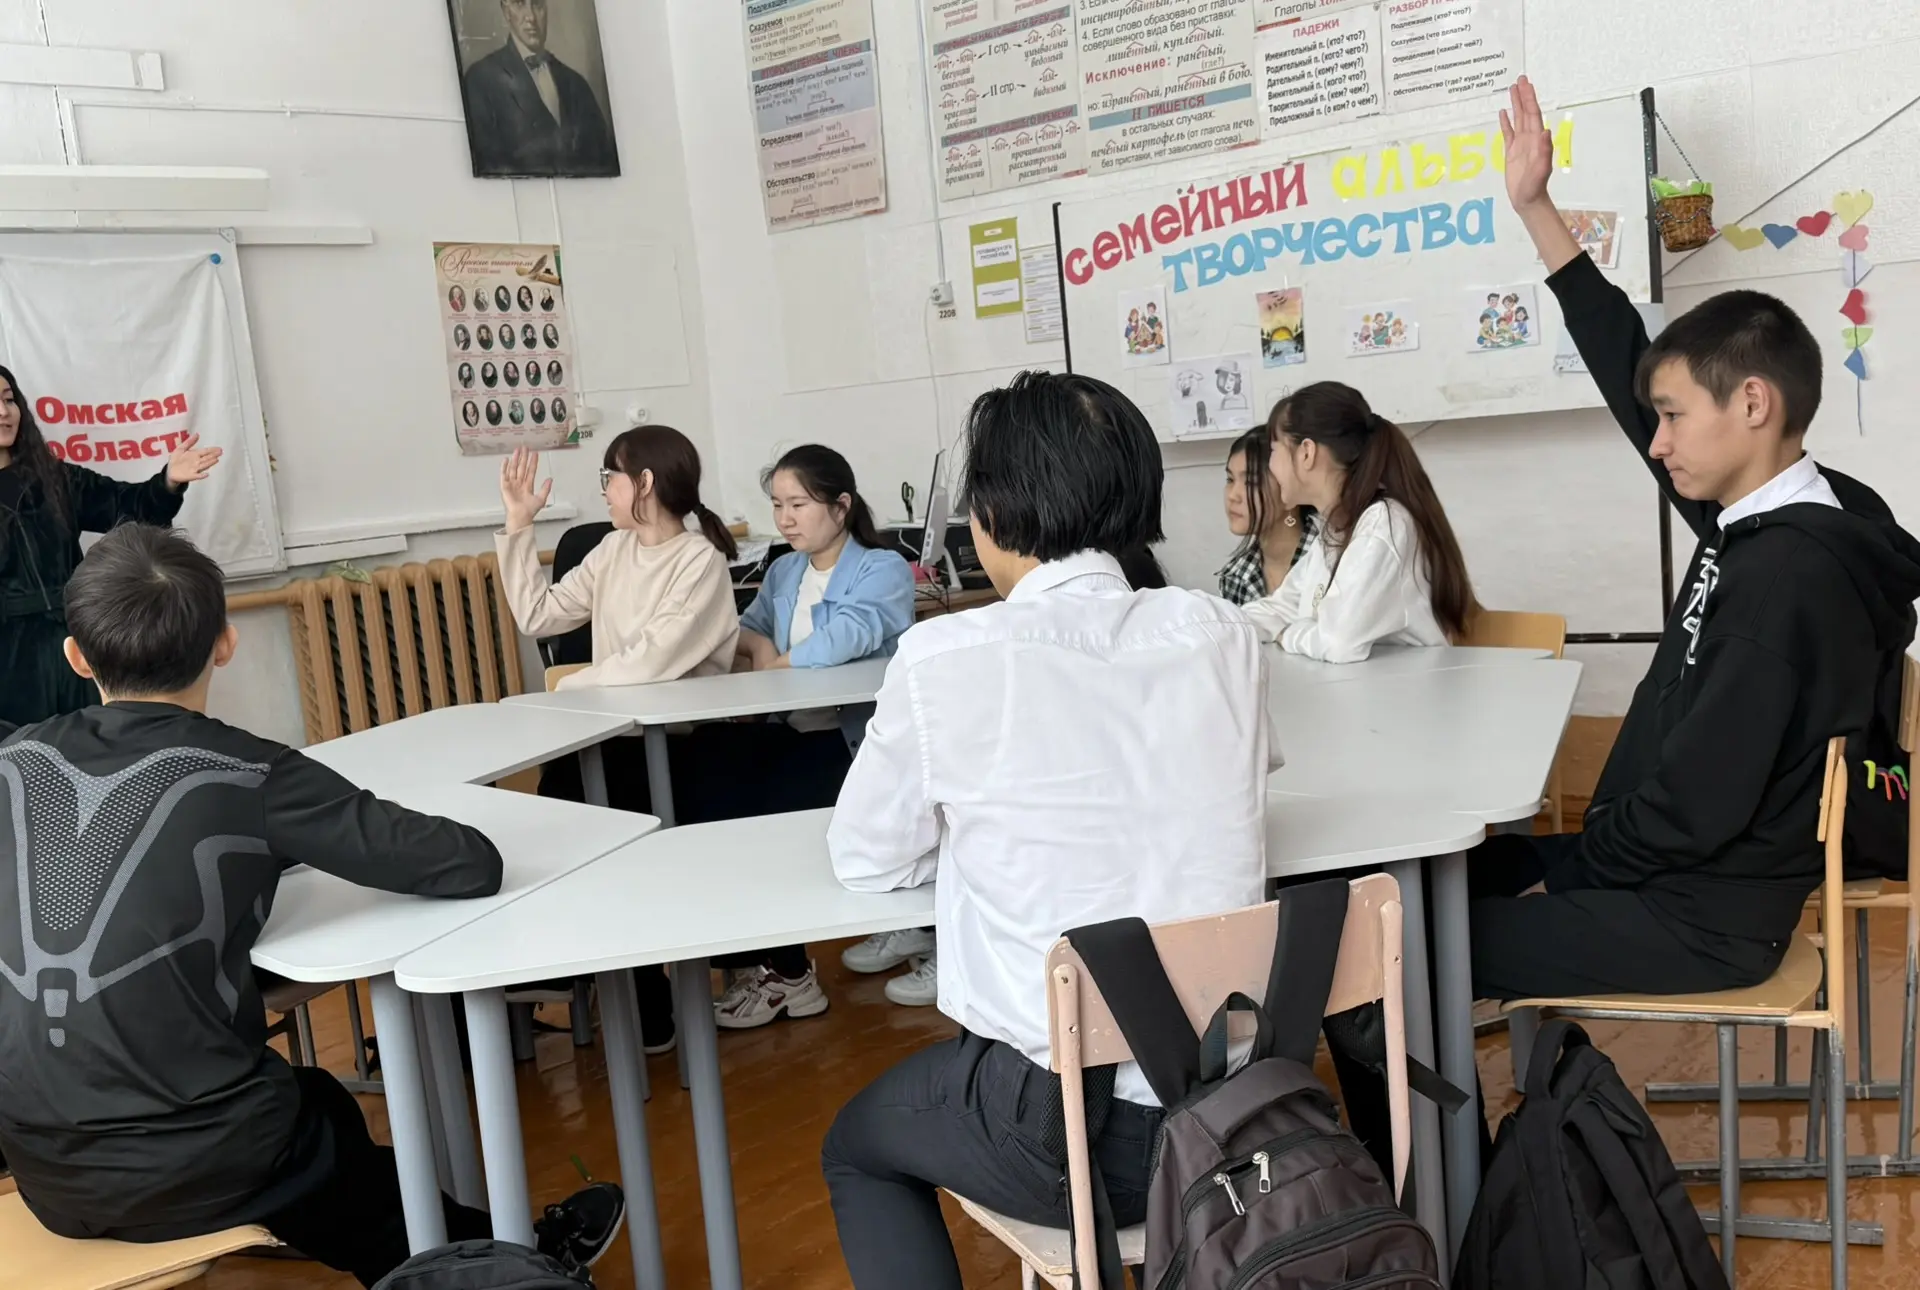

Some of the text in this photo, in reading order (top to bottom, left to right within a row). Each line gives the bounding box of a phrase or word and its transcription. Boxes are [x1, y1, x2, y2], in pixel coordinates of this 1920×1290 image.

[1274, 1, 1316, 18] Глаголы
[1389, 0, 1428, 15] РАЗБОР
[1390, 6, 1472, 30] Подлежащее (кто? что?)
[750, 18, 783, 33] Сказуемое
[1082, 32, 1090, 40] 4.
[1092, 26, 1114, 38] Если
[1115, 20, 1142, 34] слово
[1144, 6, 1196, 26] образовано
[1198, 4, 1208, 13] от
[1082, 10, 1236, 52] совершенного вида без приставки:
[1292, 18, 1340, 38] ПАДЕЖИ
[994, 42, 1011, 54] спр.
[1164, 26, 1224, 52] купленный.
[1264, 30, 1366, 62] Именительный п. (кто? что?)
[1391, 24, 1471, 47] Сказуемое (что делать?)
[1085, 44, 1226, 84] Исключение: раненый,
[1202, 56, 1225, 70] (где?)
[1266, 42, 1368, 75] Родительный п. (кого? чего?)
[1392, 38, 1483, 64] Определение (какой? чей?)
[1266, 56, 1364, 90] Дательный п. (кому? чему?)
[1393, 50, 1504, 80] Дополнение (падежные вопросы)
[754, 78, 794, 96] Дополнение
[1000, 82, 1016, 94] спр.
[1087, 68, 1252, 112] но: израненный, раненный в бою.
[1268, 69, 1367, 100] Винительный п. (кого? что?)
[1393, 68, 1508, 97] Обстоятельство (где? куда? когда?
[1448, 82, 1475, 94] откуда?
[1476, 78, 1494, 90] как?)
[1132, 94, 1205, 120] Н ПИШЕТСЯ
[1268, 82, 1370, 113] Творительный п. (кем? чем?)
[1270, 107, 1314, 127] Предложный
[1316, 108, 1322, 116] п.
[1324, 104, 1331, 116] (о
[1333, 100, 1350, 111] ком?
[1357, 94, 1378, 106] чем?)
[1122, 110, 1216, 136] в остальных случаях:
[1131, 132, 1186, 152] картофель
[1187, 130, 1199, 140] (от
[1200, 124, 1231, 137] глагола
[1232, 118, 1255, 130] печь
[1101, 158, 1114, 168] без
[1114, 152, 1152, 167] приставки,
[1154, 148, 1166, 158] нет
[1167, 140, 1213, 155] зависимого
[766, 172, 816, 189] Обстоятельство
[36, 393, 188, 425] Омская
